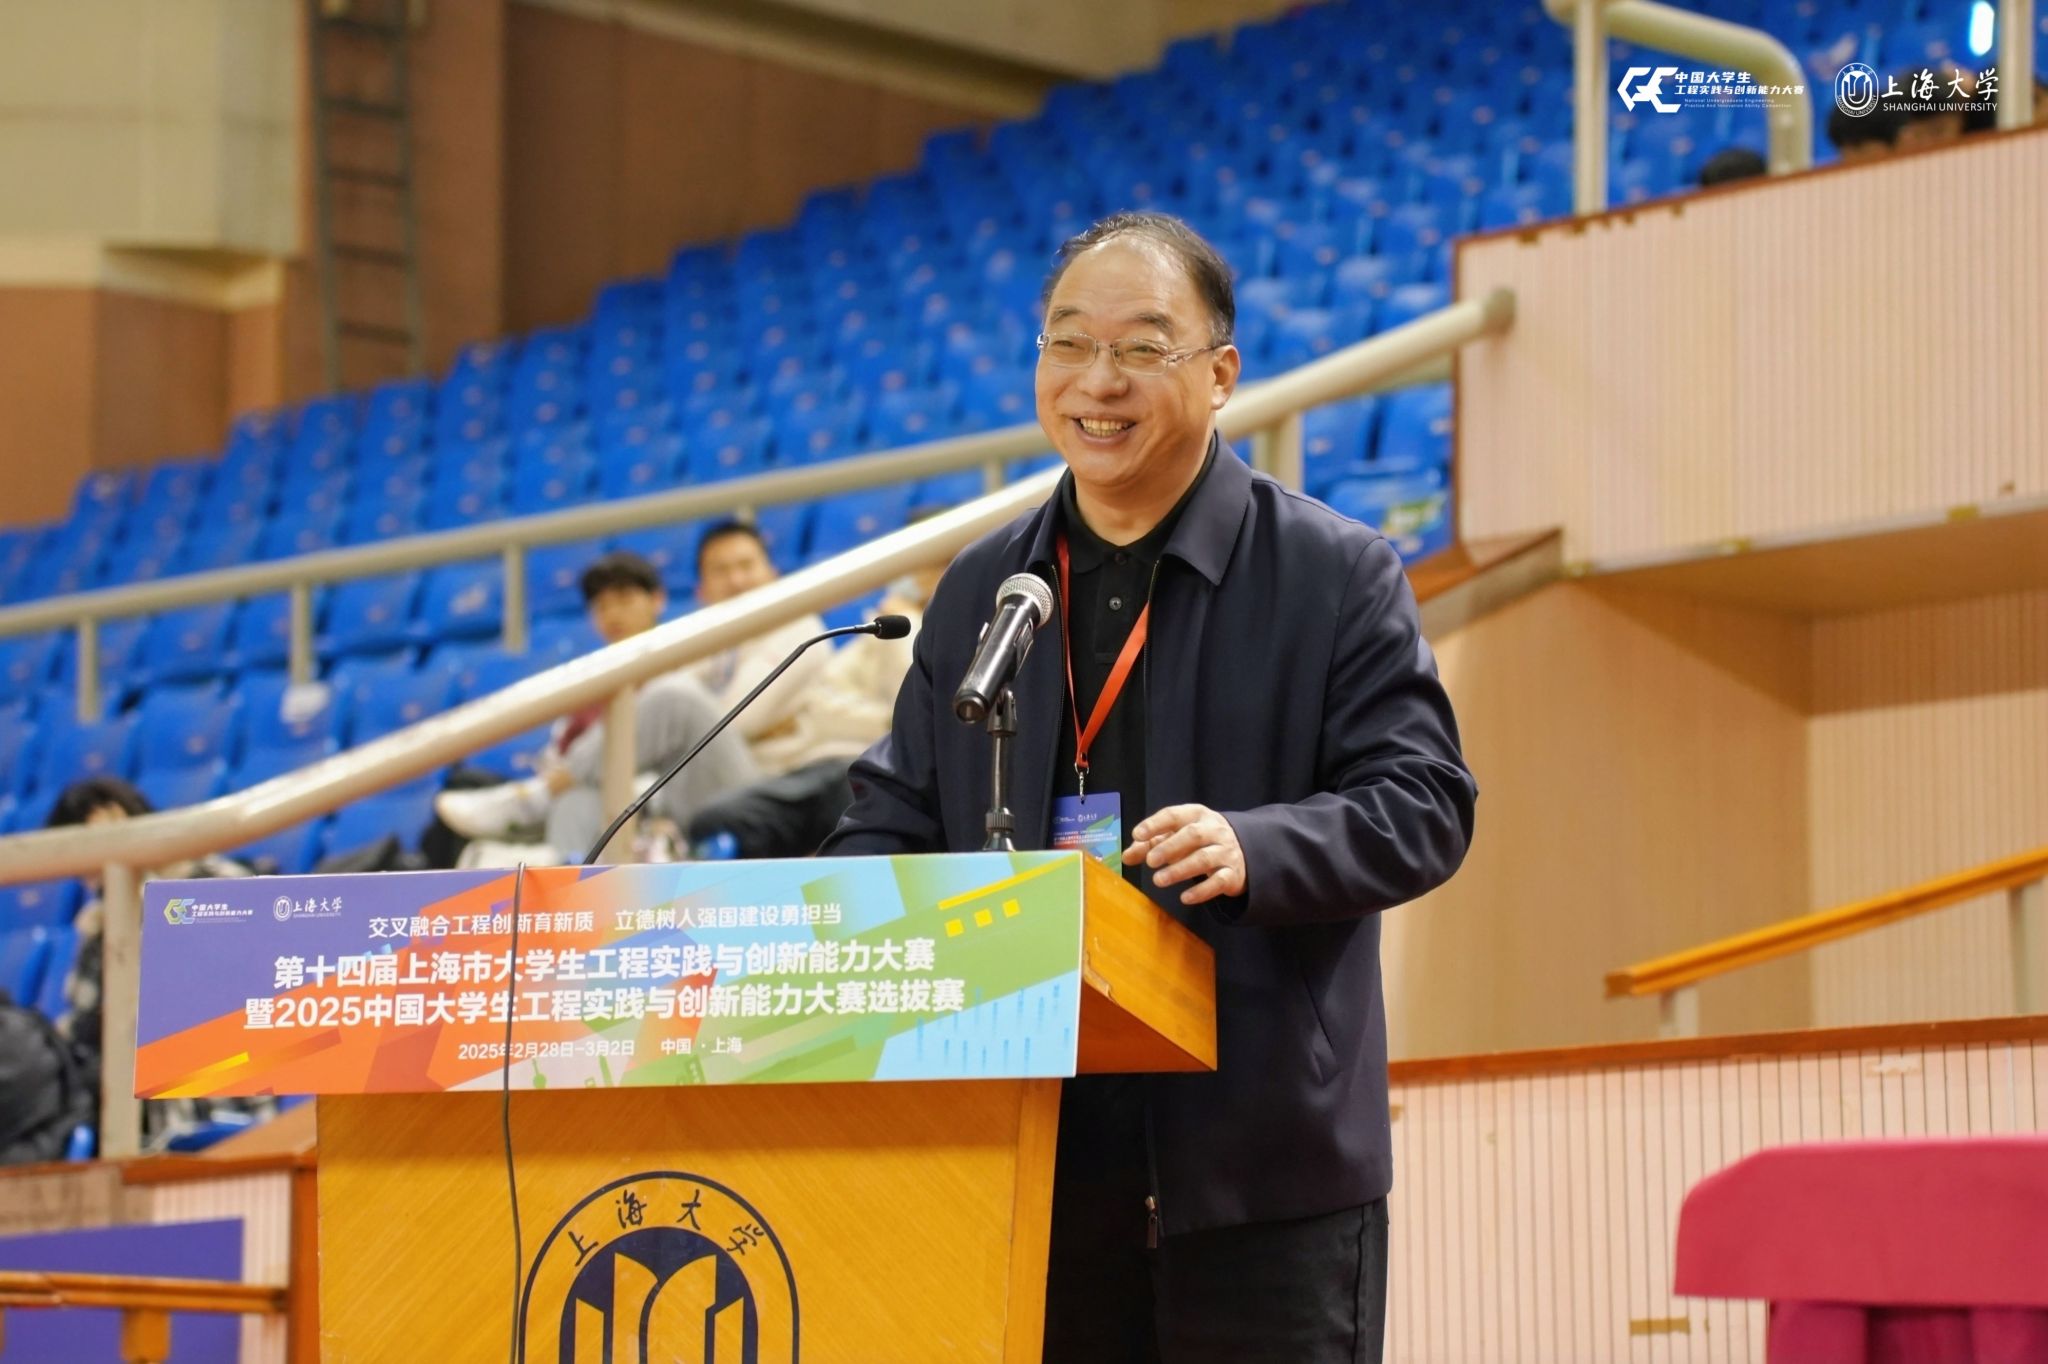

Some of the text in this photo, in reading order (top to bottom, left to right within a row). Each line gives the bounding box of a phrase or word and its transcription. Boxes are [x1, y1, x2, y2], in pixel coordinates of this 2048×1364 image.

[293, 896, 343, 913] 上海大学
[368, 903, 842, 938] 交叉融合工程创新育新质 立德树人强国建设勇担当
[273, 937, 936, 990] 第十四届上海市大学生工程实践与创新能力大赛
[243, 978, 966, 1029] 暨2025中国大学生工程实践与创新能力大赛选拔赛
[568, 1189, 764, 1267] 上海大学
